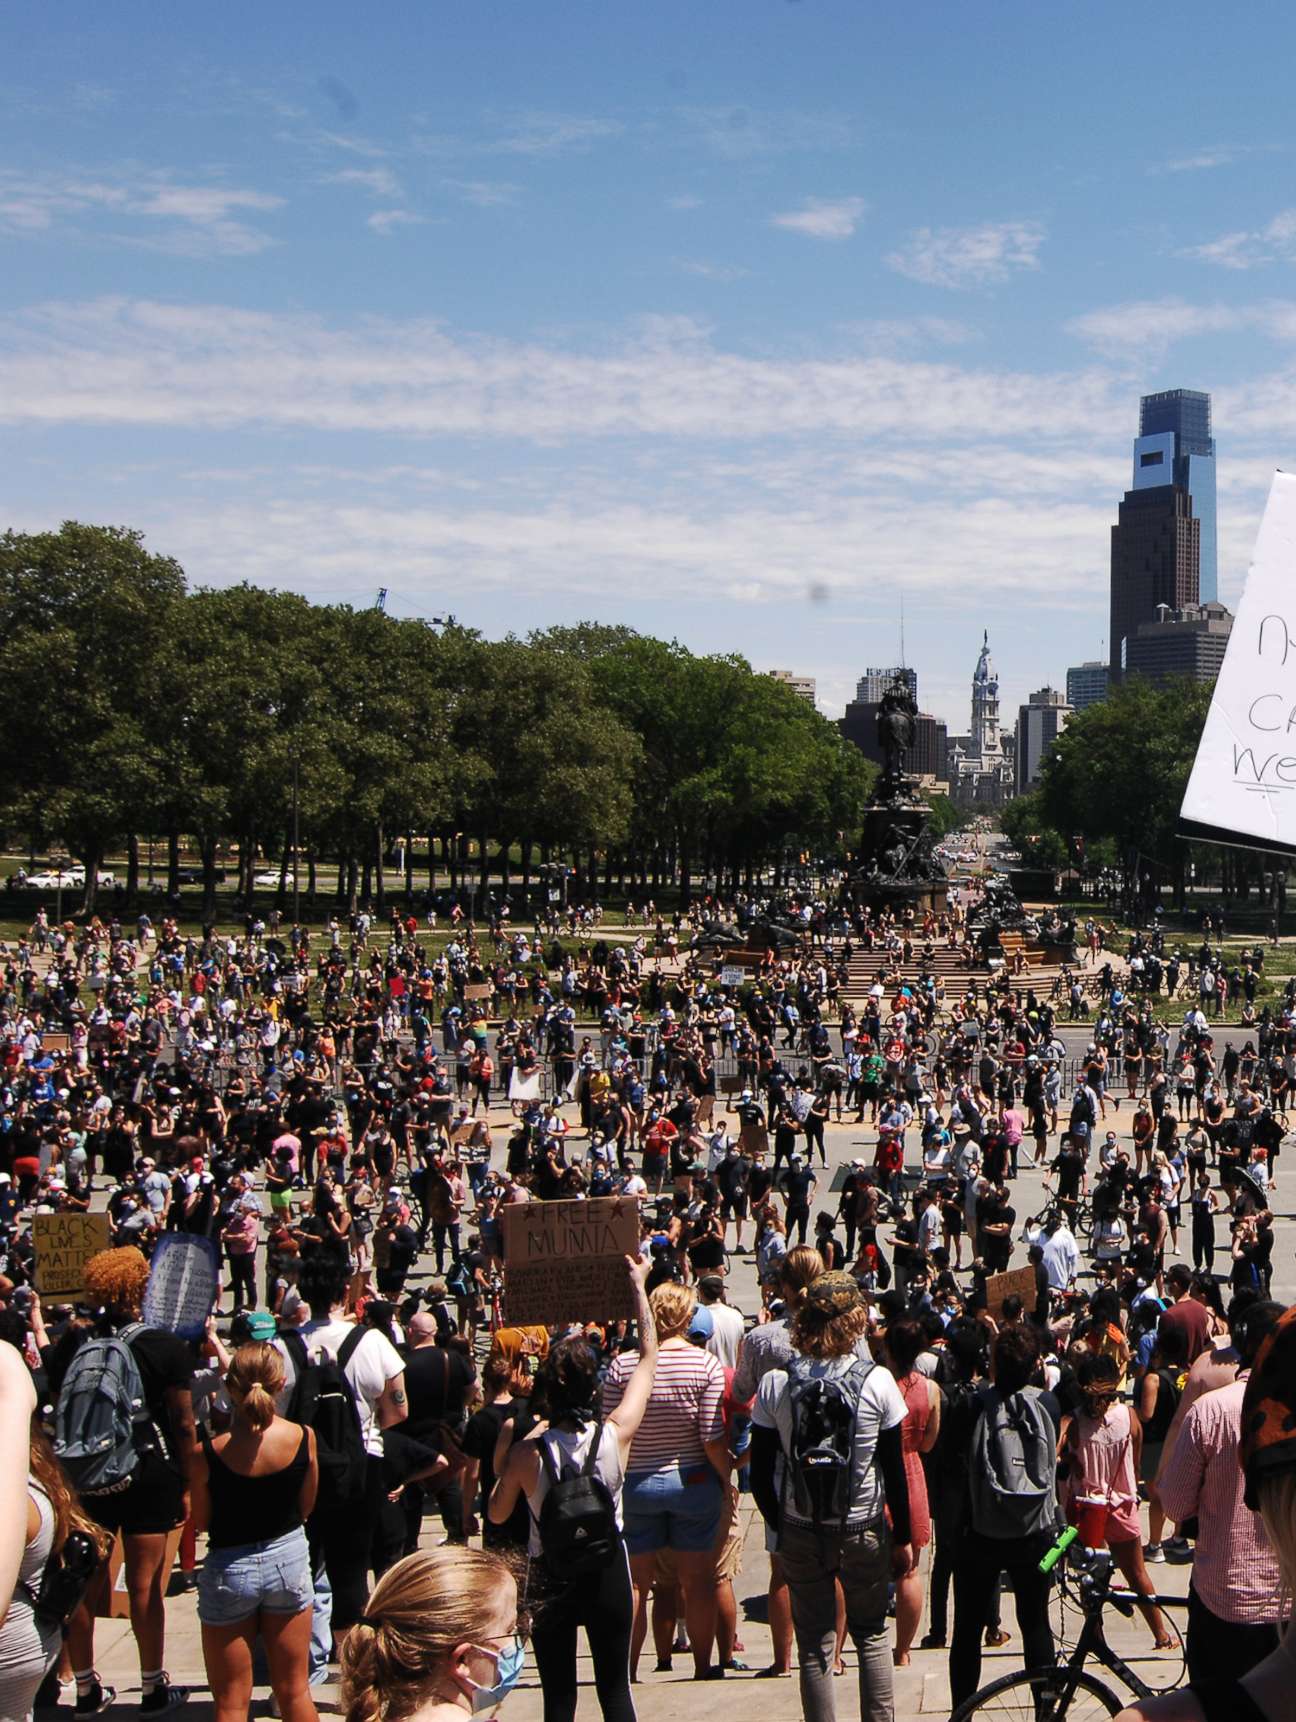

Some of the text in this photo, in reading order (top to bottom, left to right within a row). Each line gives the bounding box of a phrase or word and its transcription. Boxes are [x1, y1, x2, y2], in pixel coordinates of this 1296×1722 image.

[541, 1201, 602, 1224] FREE
[35, 1218, 98, 1236] BLACK
[50, 1235, 92, 1249] LIVES
[528, 1225, 619, 1257] MUMIA
